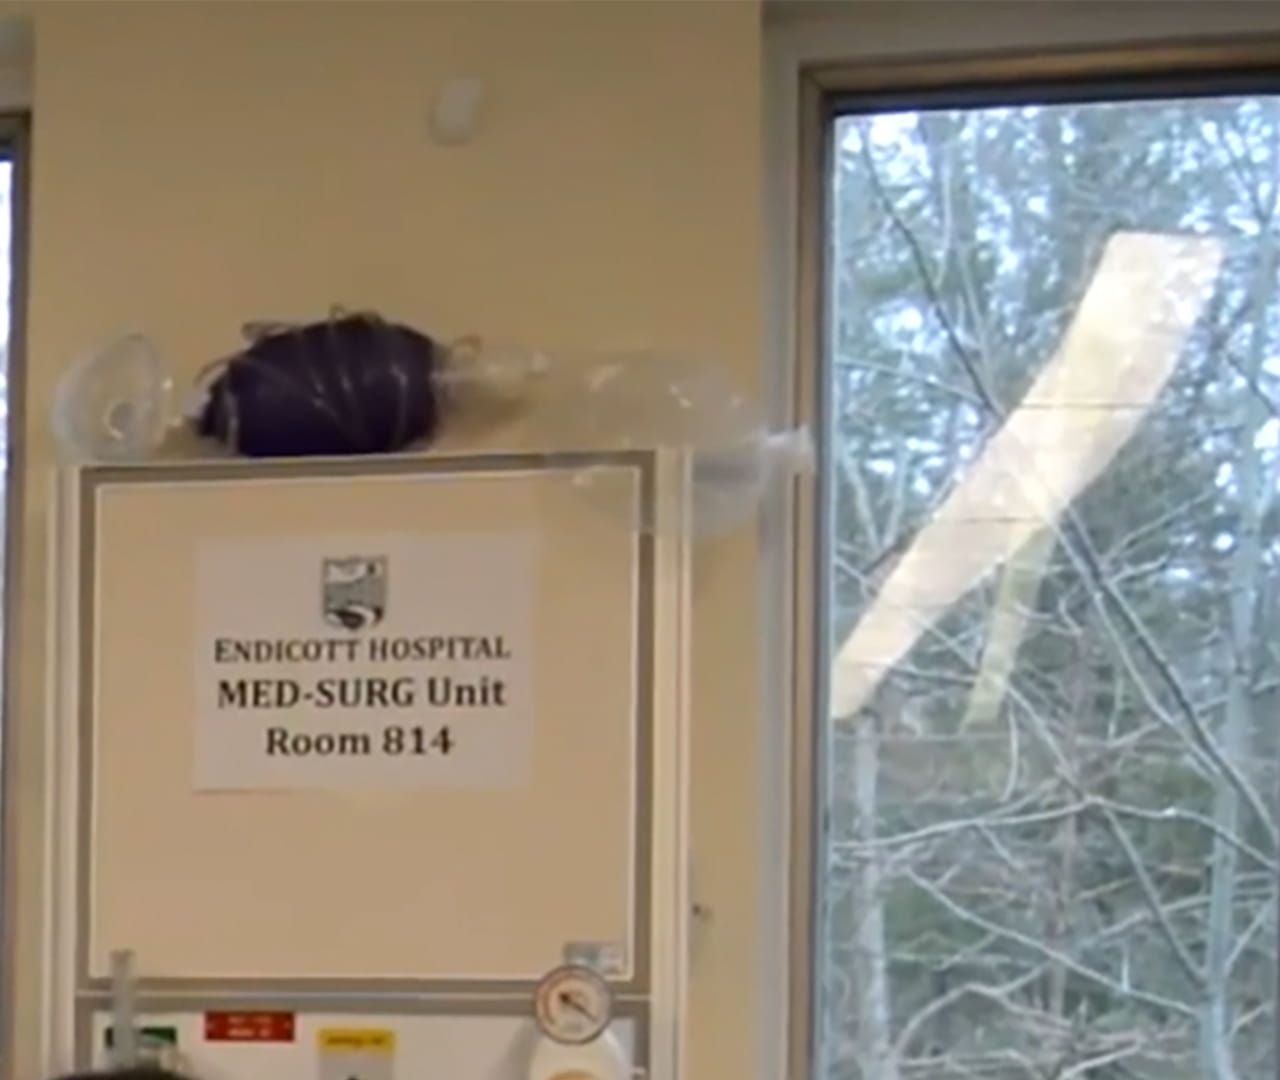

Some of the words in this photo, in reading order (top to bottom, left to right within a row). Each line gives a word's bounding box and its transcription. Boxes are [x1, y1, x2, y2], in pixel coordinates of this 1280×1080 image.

[214, 638, 359, 663] ENDICOTT
[369, 636, 511, 661] HOSPITAL
[217, 677, 415, 709] MED-SURG
[427, 676, 507, 707] Unit
[265, 727, 371, 756] Room
[382, 725, 454, 756] 814
